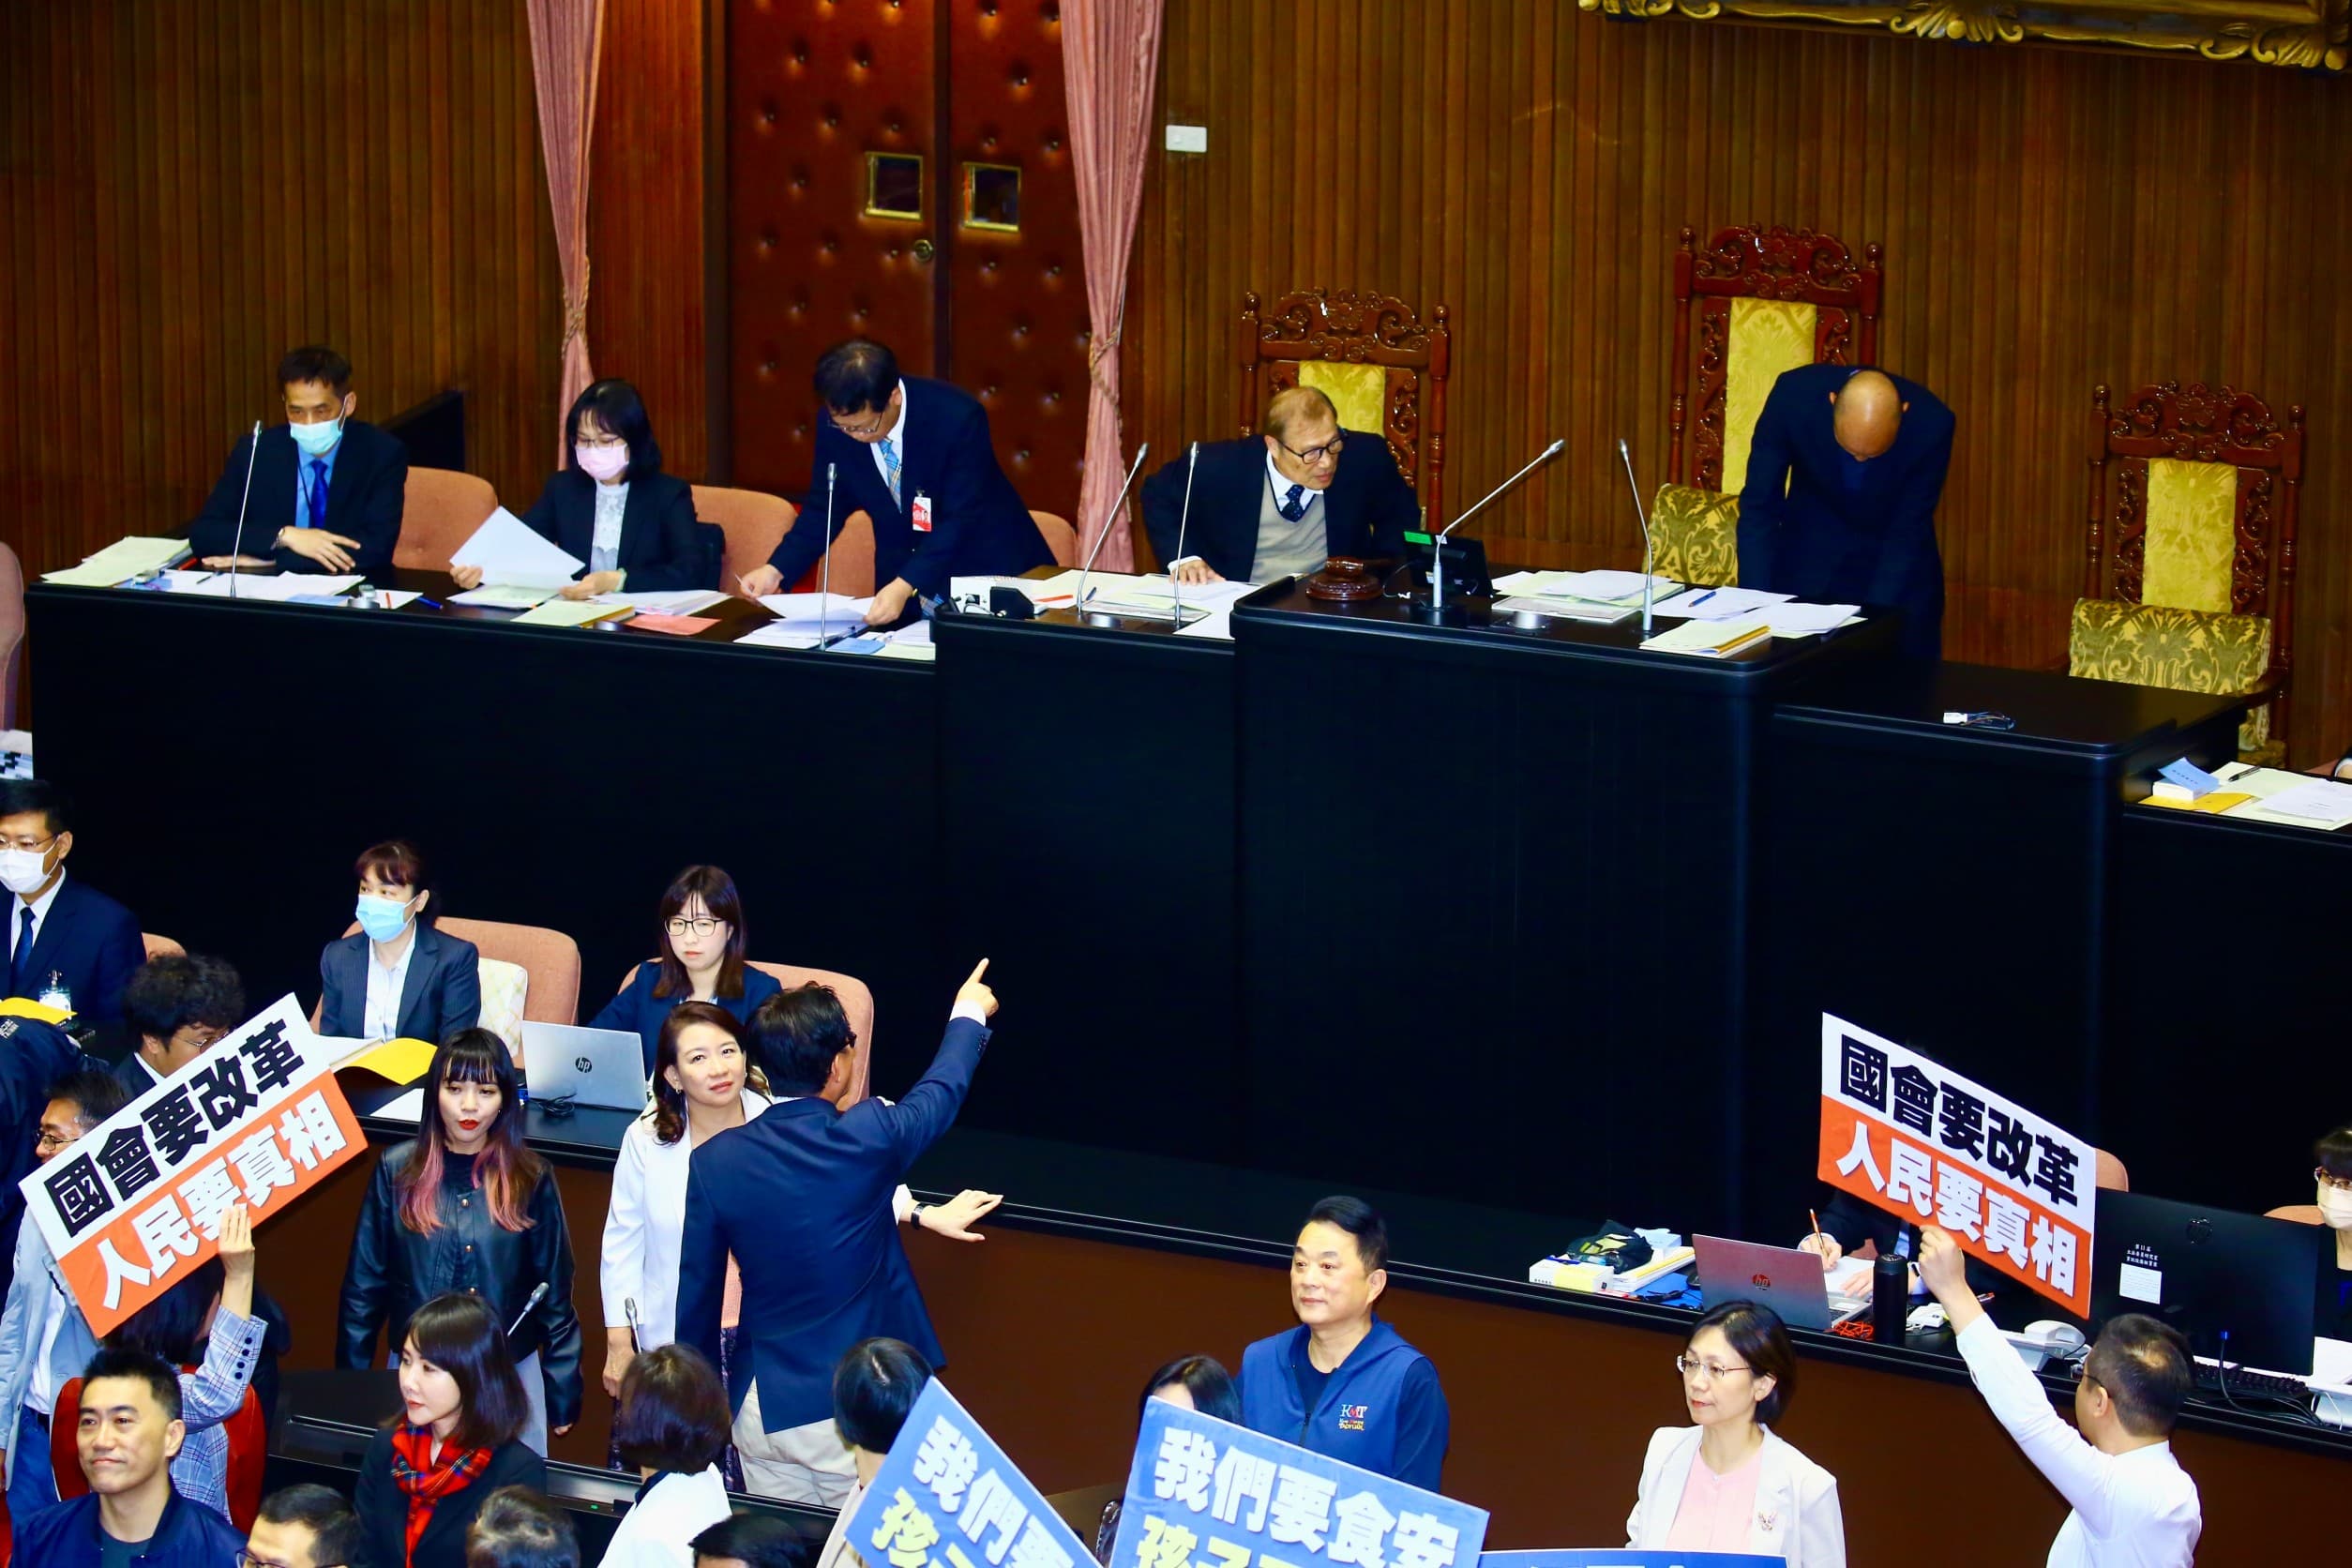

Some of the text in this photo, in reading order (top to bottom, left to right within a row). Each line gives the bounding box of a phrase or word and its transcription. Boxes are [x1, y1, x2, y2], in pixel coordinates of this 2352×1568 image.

[44, 1018, 305, 1238] 國會要改革
[576, 1057, 593, 1074] hp
[1841, 1033, 2078, 1207] 國會要改革
[98, 1090, 347, 1310] 人民要真相
[1836, 1120, 2076, 1298] 人民要真相
[1339, 1404, 1368, 1419] KMT
[871, 1486, 975, 1568] 孩
[1154, 1426, 1459, 1568] 我們要食安
